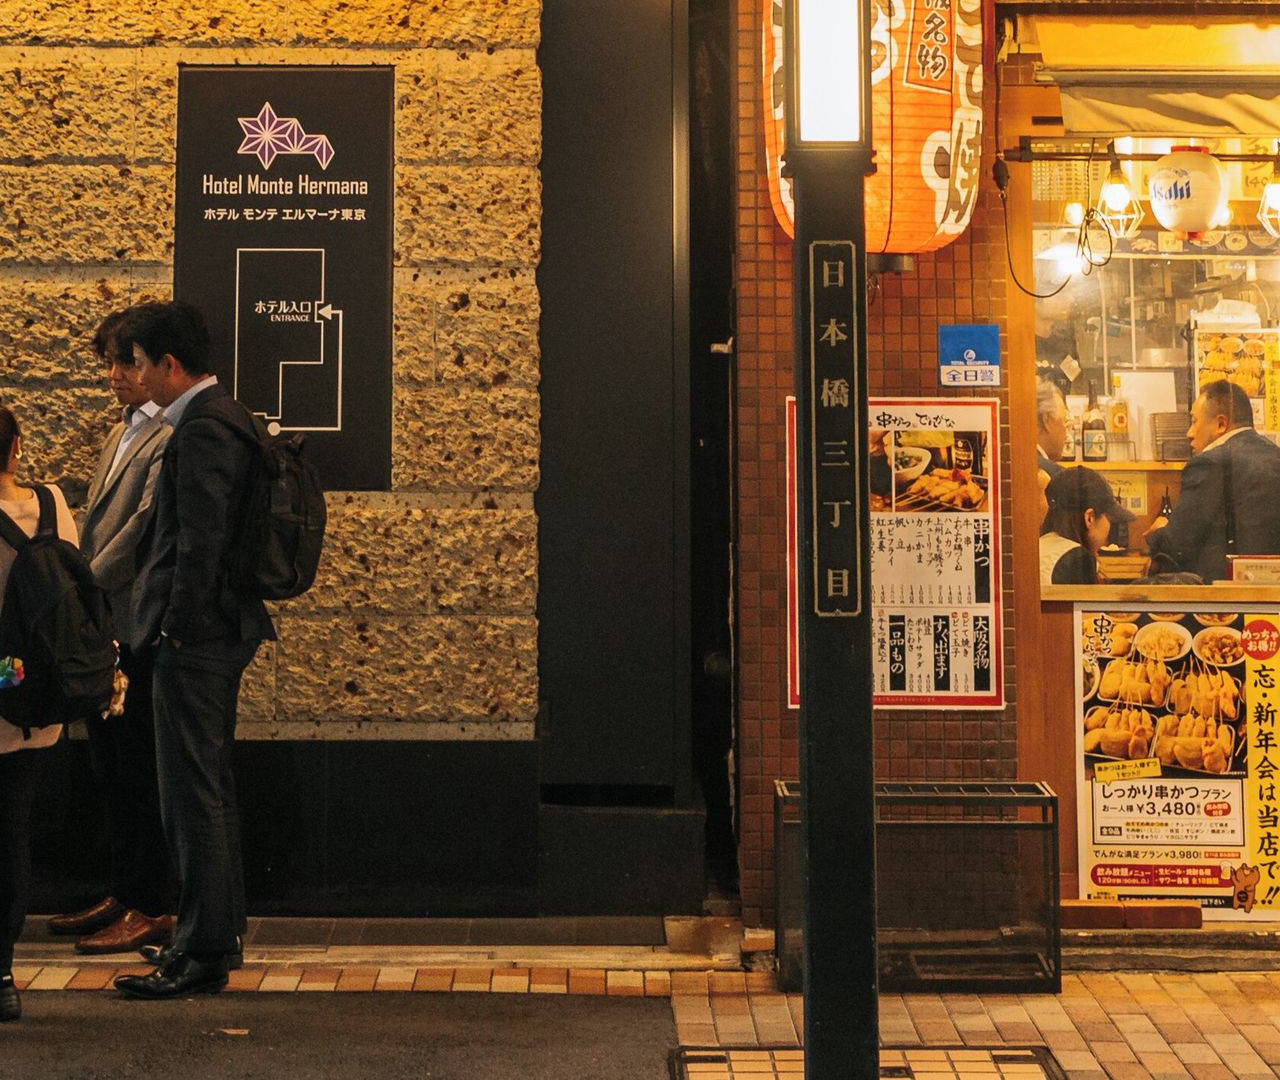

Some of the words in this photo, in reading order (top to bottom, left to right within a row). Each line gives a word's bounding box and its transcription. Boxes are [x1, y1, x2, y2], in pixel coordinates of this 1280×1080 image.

[202, 174, 243, 197] Hotel
[247, 174, 293, 197] Monte
[298, 174, 369, 197] Hermana
[203, 207, 239, 222] ホテル
[242, 207, 278, 222] モンテ
[281, 207, 366, 222] エルマーナ東京
[254, 300, 311, 314] ホテル入口
[819, 259, 851, 599] 日本橋三丁目
[974, 519, 990, 568] 串かつ
[889, 621, 905, 674] 一品もの
[933, 618, 950, 680] すぐ出ます
[973, 617, 990, 669] 大阪名物
[1102, 785, 1232, 800] しっかり串かつプラン
[1102, 804, 1135, 813] お一人様
